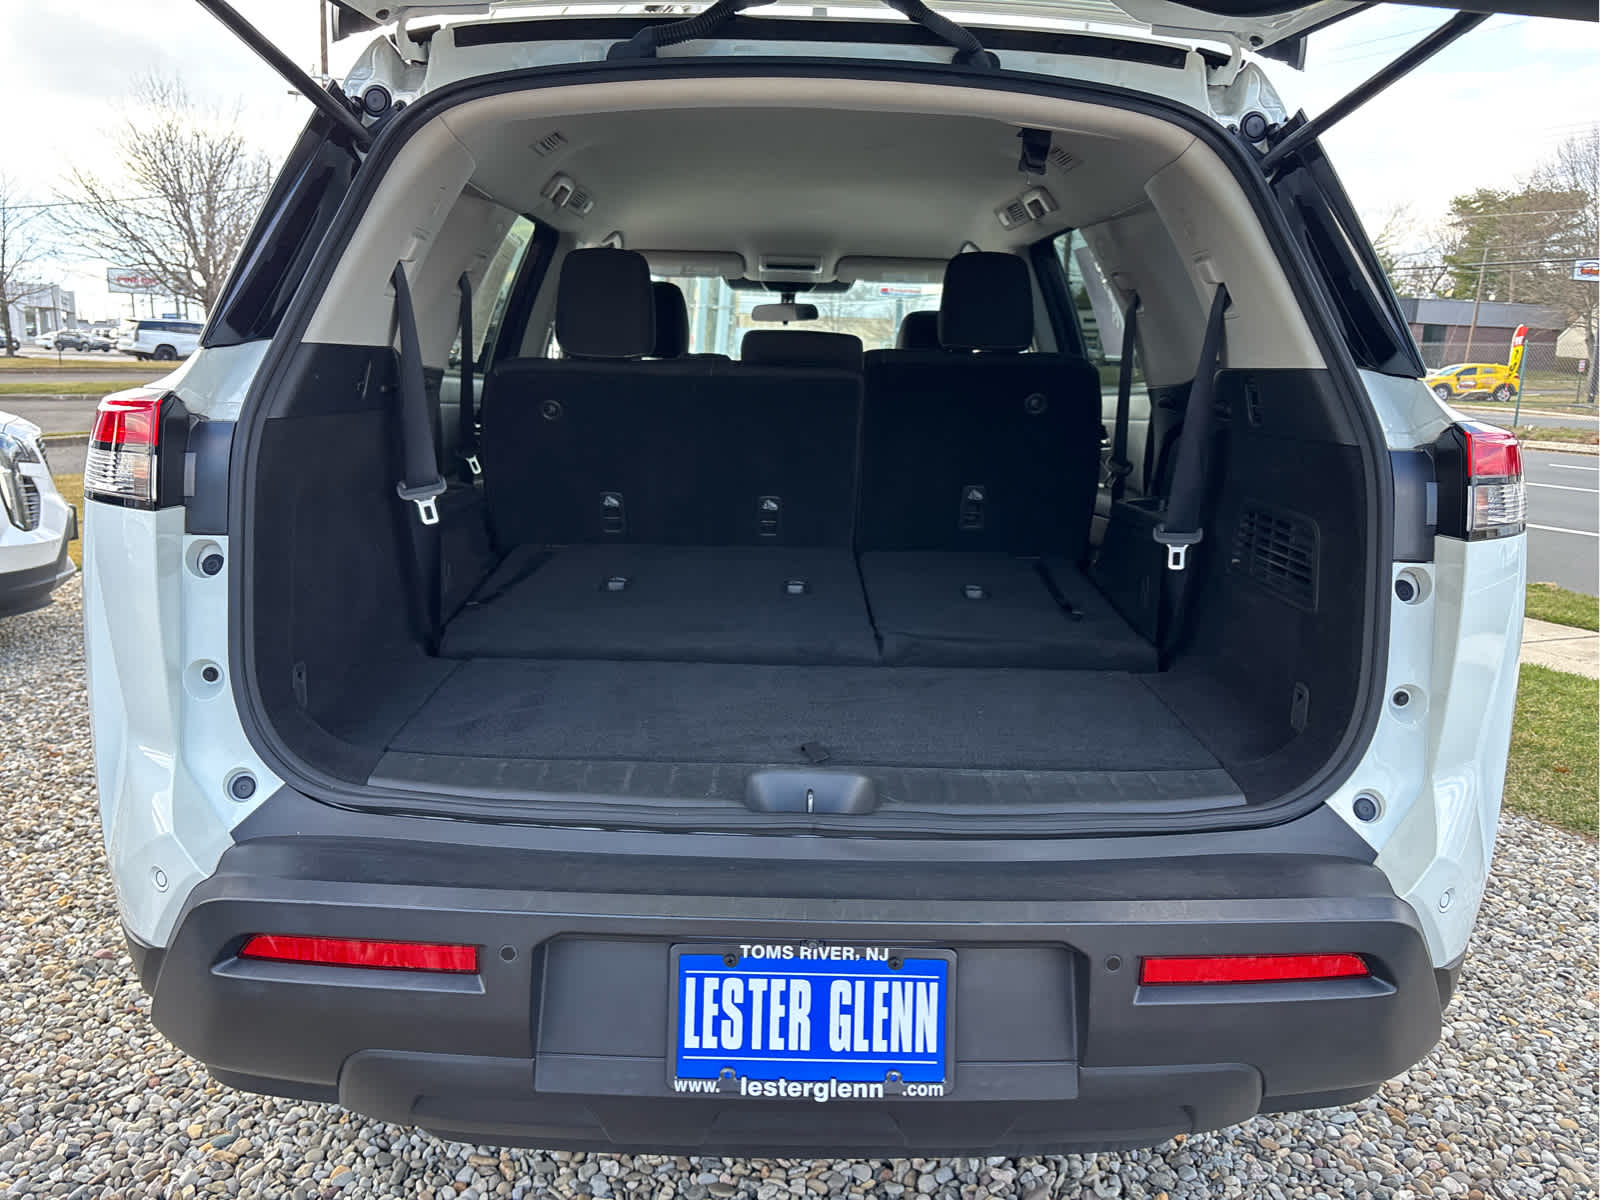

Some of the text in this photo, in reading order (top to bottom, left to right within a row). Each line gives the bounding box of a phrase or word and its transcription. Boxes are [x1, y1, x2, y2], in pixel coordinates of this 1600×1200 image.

[740, 945, 888, 961] TOMS RIVER, NJ
[684, 977, 938, 1053] LESTER GLENN
[674, 1077, 943, 1102] www. lesterglenn .com
